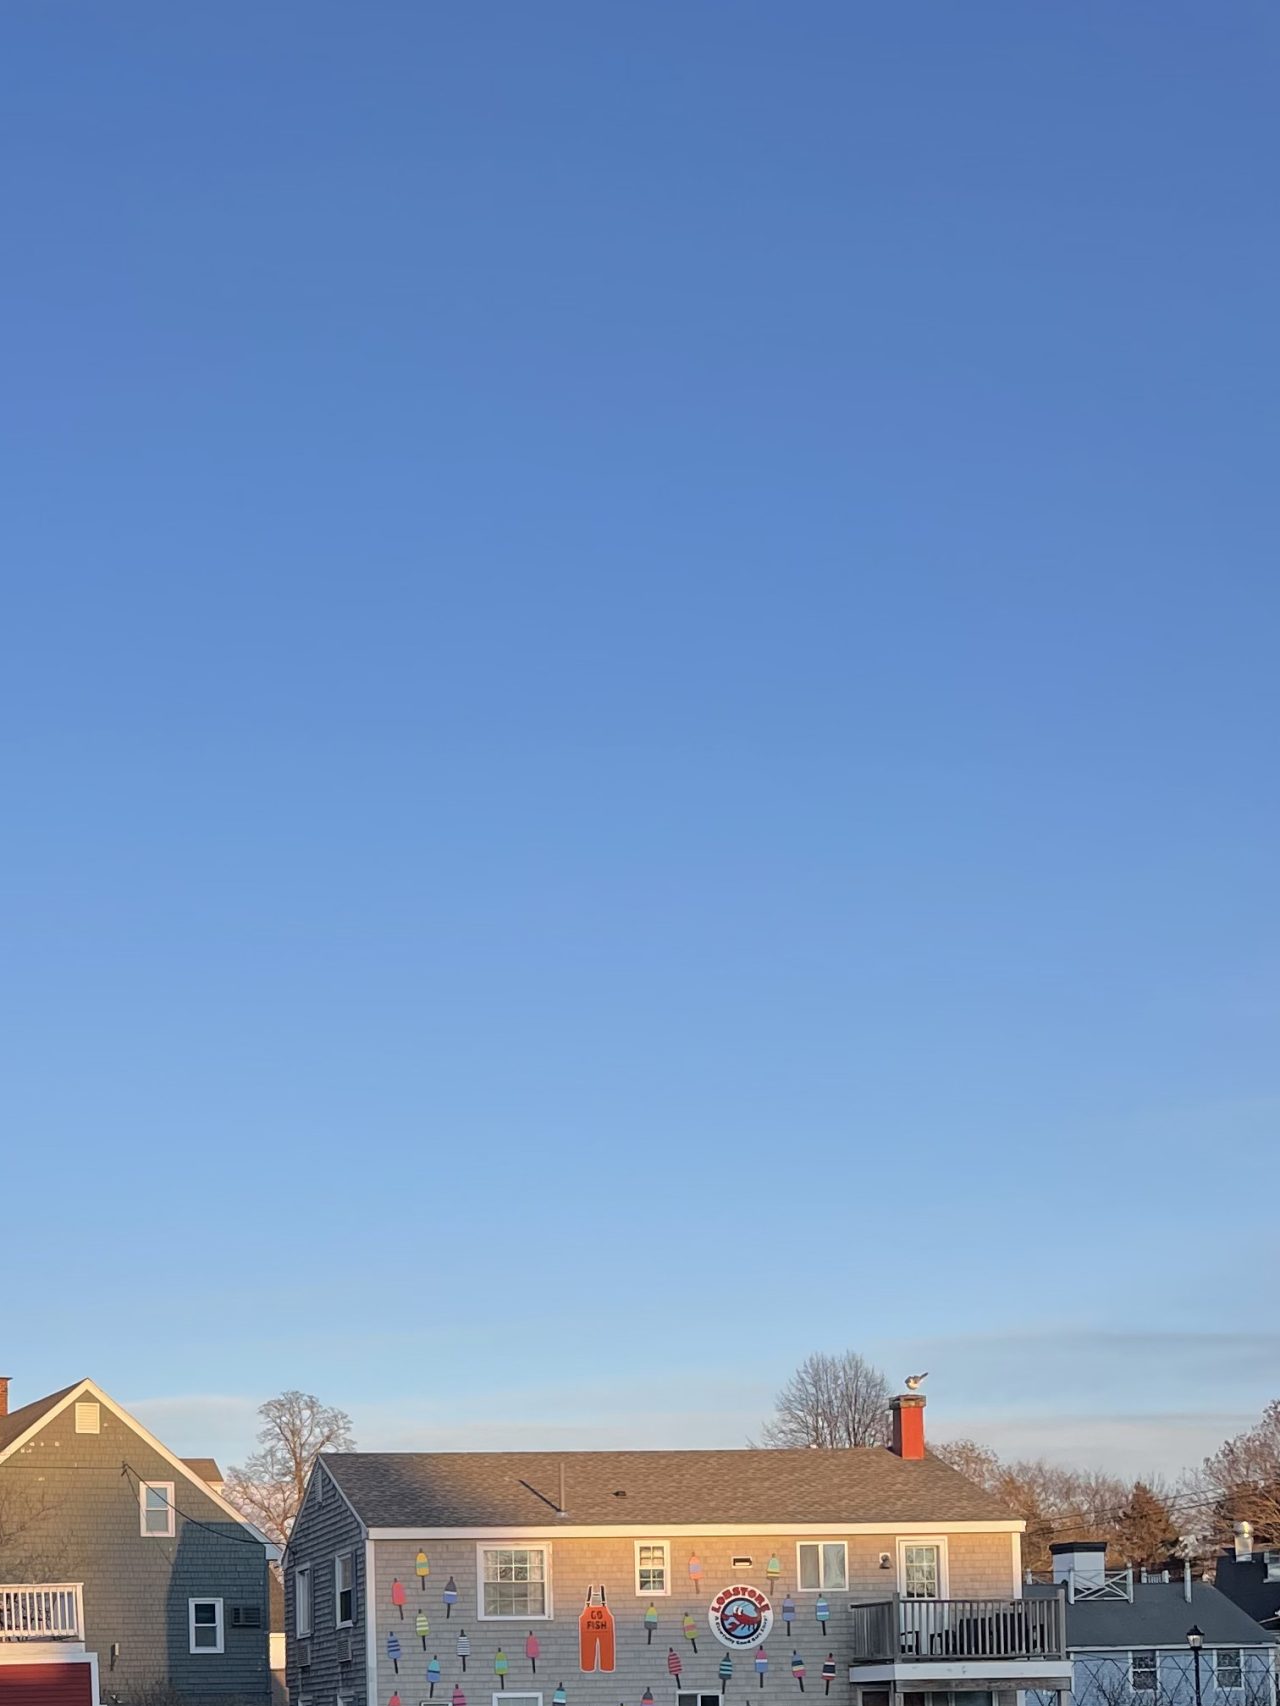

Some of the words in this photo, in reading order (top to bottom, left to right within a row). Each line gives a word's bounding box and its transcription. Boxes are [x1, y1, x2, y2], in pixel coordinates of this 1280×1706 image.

[711, 1586, 771, 1613] LOBSTORE
[590, 1610, 603, 1620] GO
[586, 1620, 607, 1630] FISH
